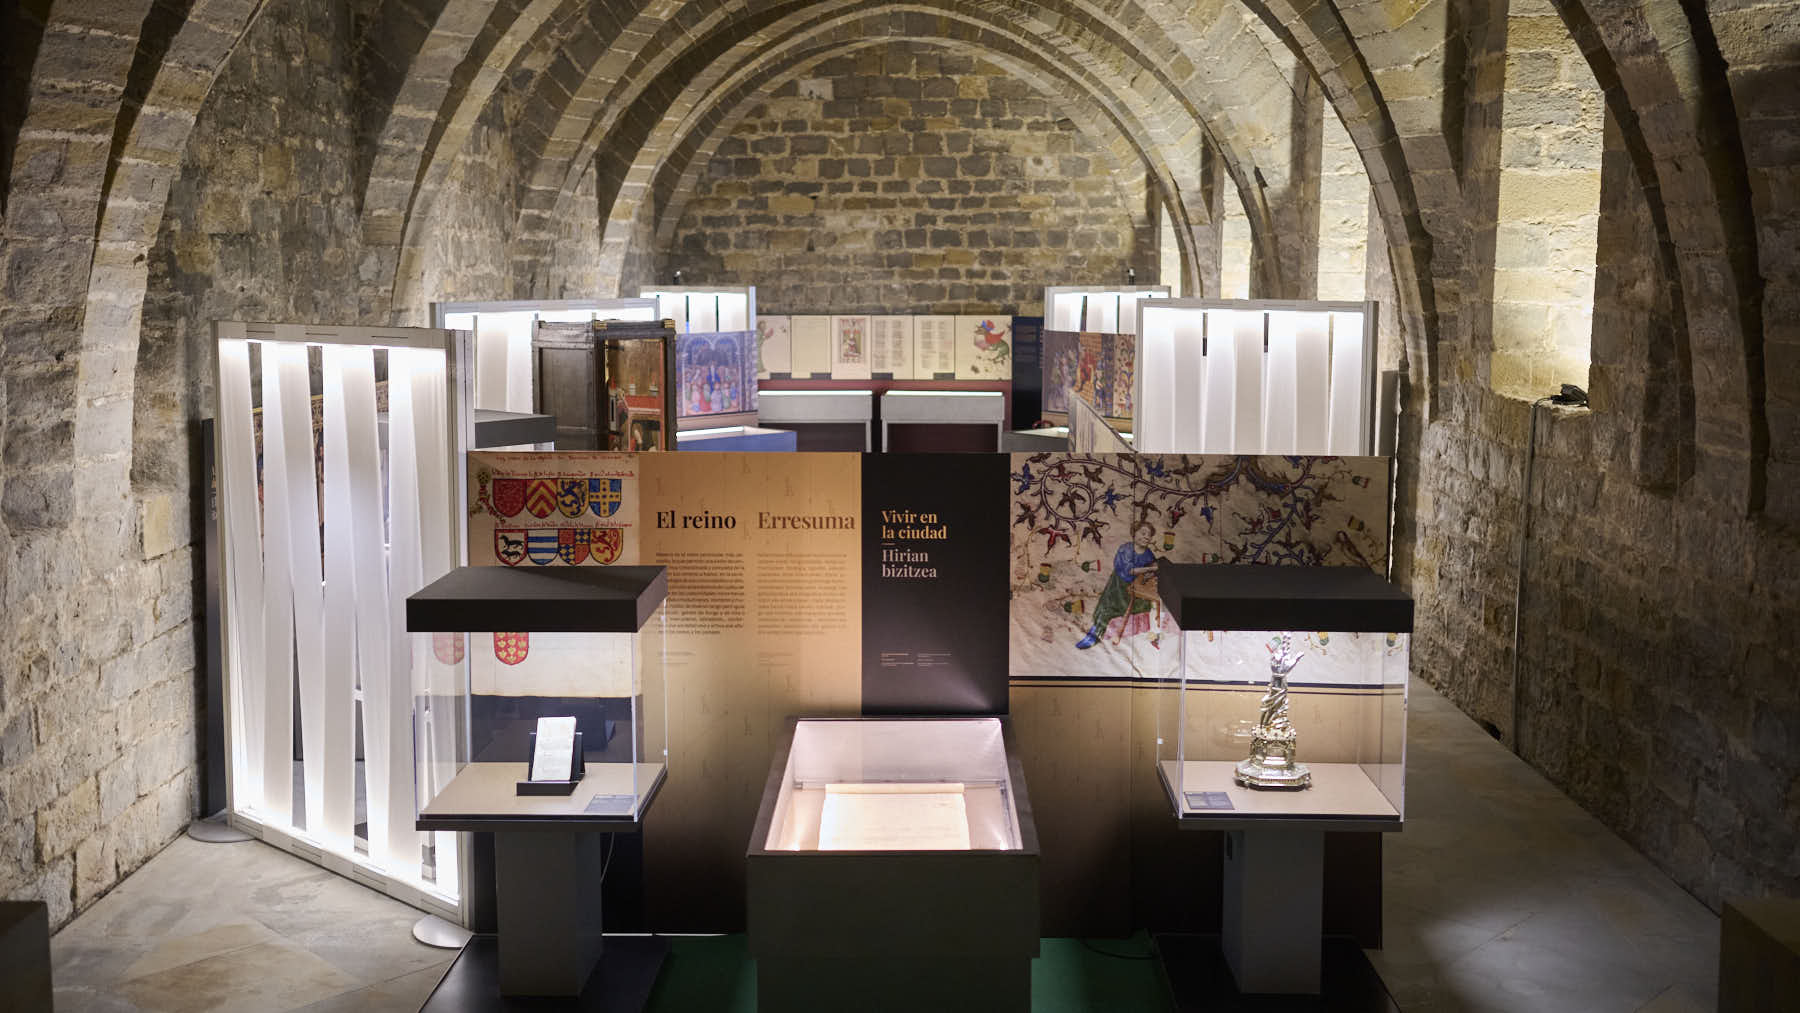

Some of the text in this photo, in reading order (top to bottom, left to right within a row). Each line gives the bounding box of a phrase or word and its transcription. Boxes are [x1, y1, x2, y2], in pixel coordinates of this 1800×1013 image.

[656, 510, 737, 530] El reino
[757, 511, 857, 530] Erresuma
[881, 509, 938, 525] Vivir en
[881, 524, 948, 540] la ciudad
[881, 548, 930, 563] Hirian
[881, 563, 938, 578] bizitzea
